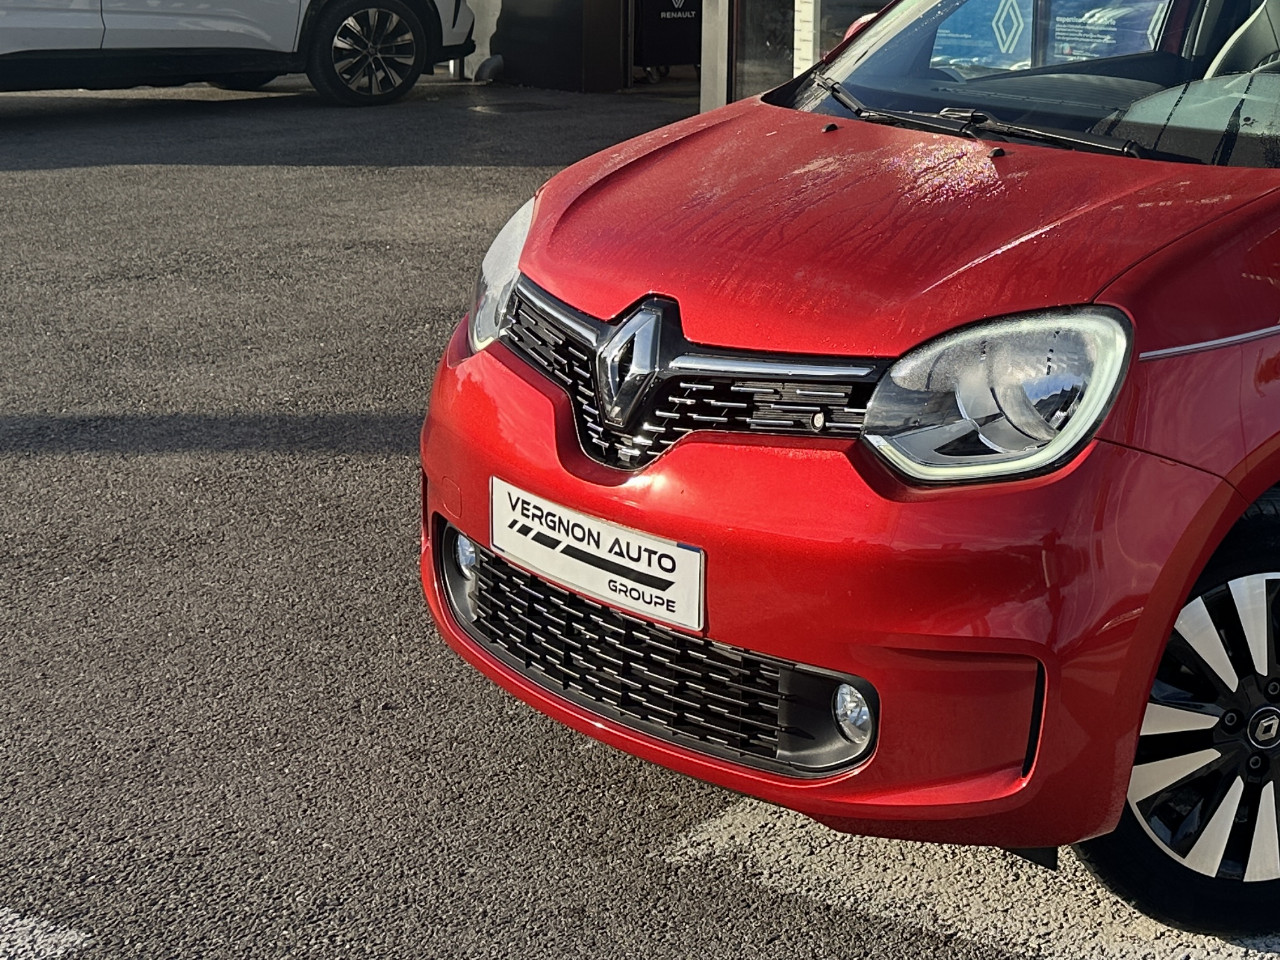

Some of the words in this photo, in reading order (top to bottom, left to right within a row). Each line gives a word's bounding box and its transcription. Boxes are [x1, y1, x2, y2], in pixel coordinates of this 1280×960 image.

[660, 10, 696, 19] RENAULT
[507, 491, 601, 550] VERGNON
[608, 537, 676, 574] AUTO
[608, 579, 676, 613] GROUPE
